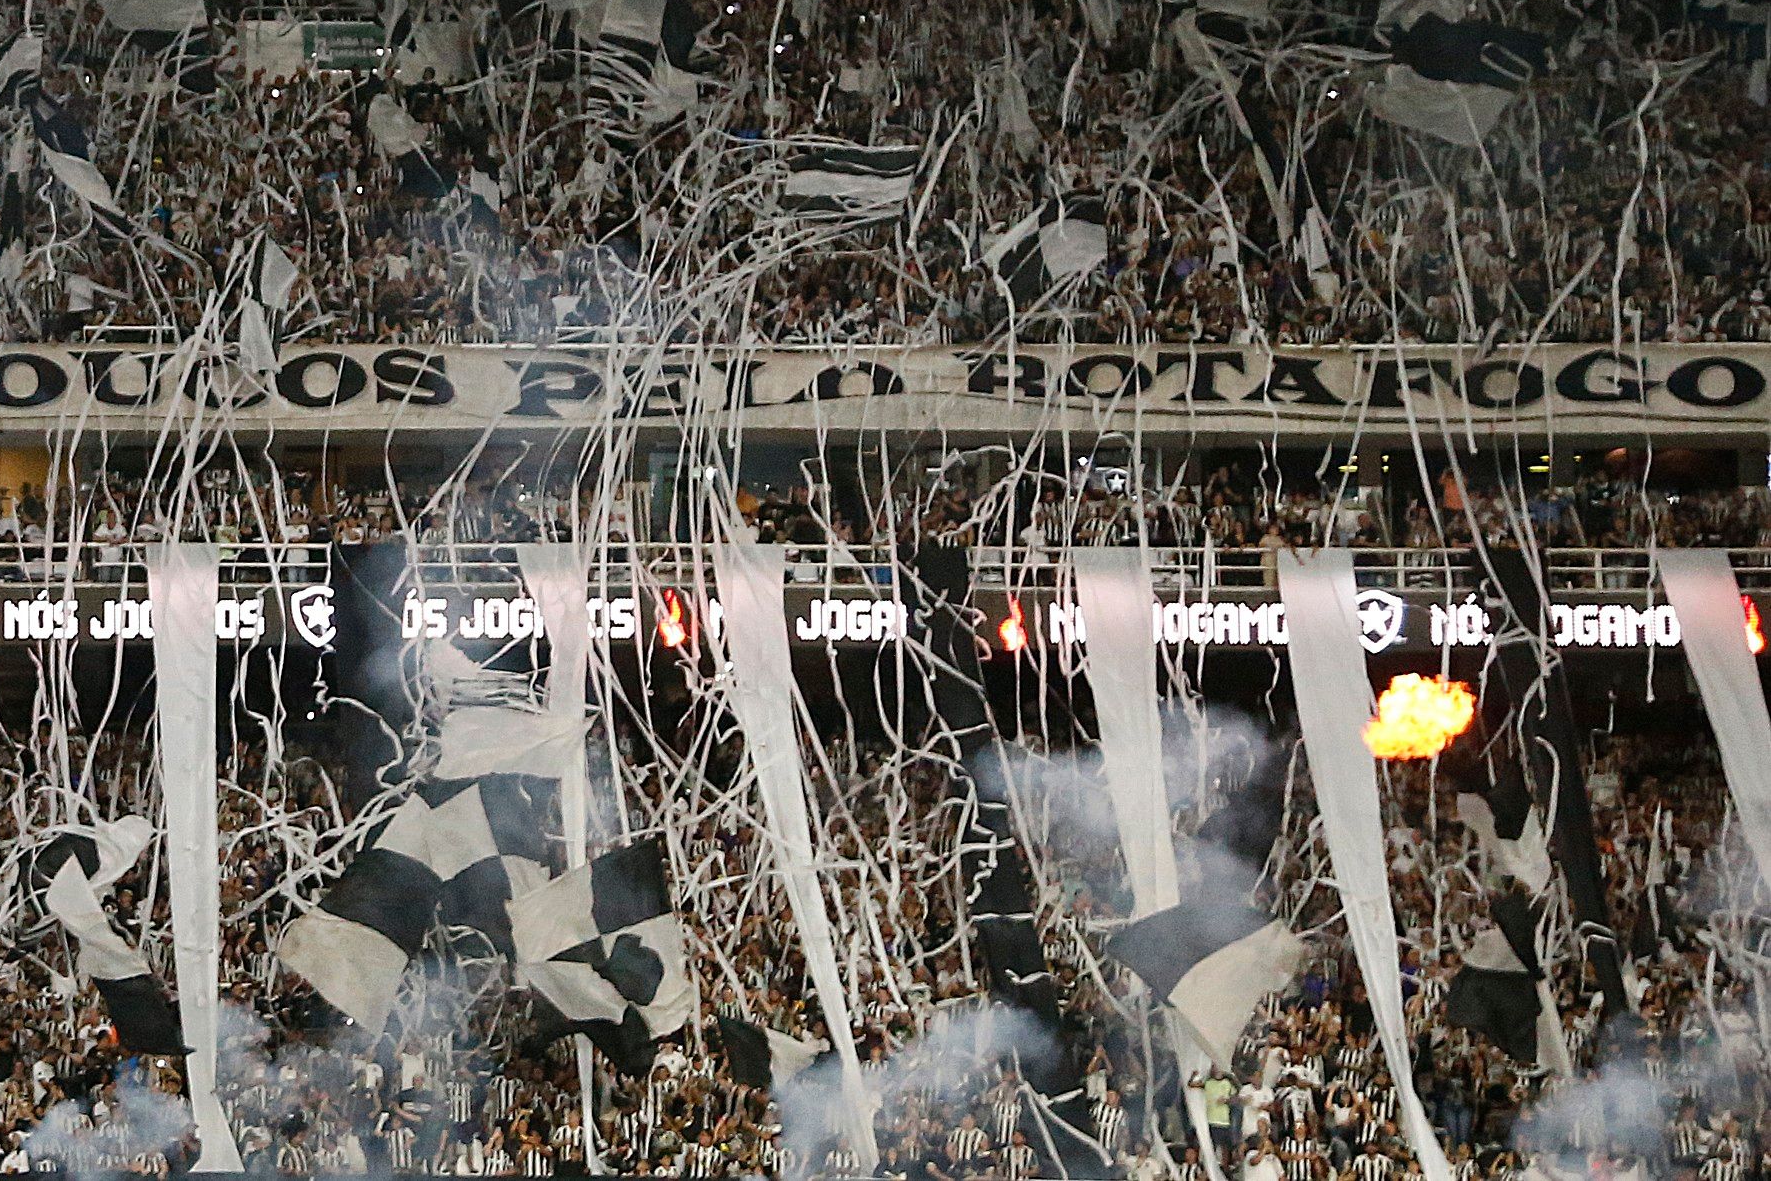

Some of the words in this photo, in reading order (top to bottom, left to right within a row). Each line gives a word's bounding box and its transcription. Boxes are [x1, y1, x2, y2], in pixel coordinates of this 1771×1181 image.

[503, 359, 904, 420] PELO
[953, 350, 1766, 407] BOTAFOGO
[4, 589, 78, 640] NÓS
[401, 588, 447, 640] ÓS
[1550, 605, 1681, 647] OGAMO
